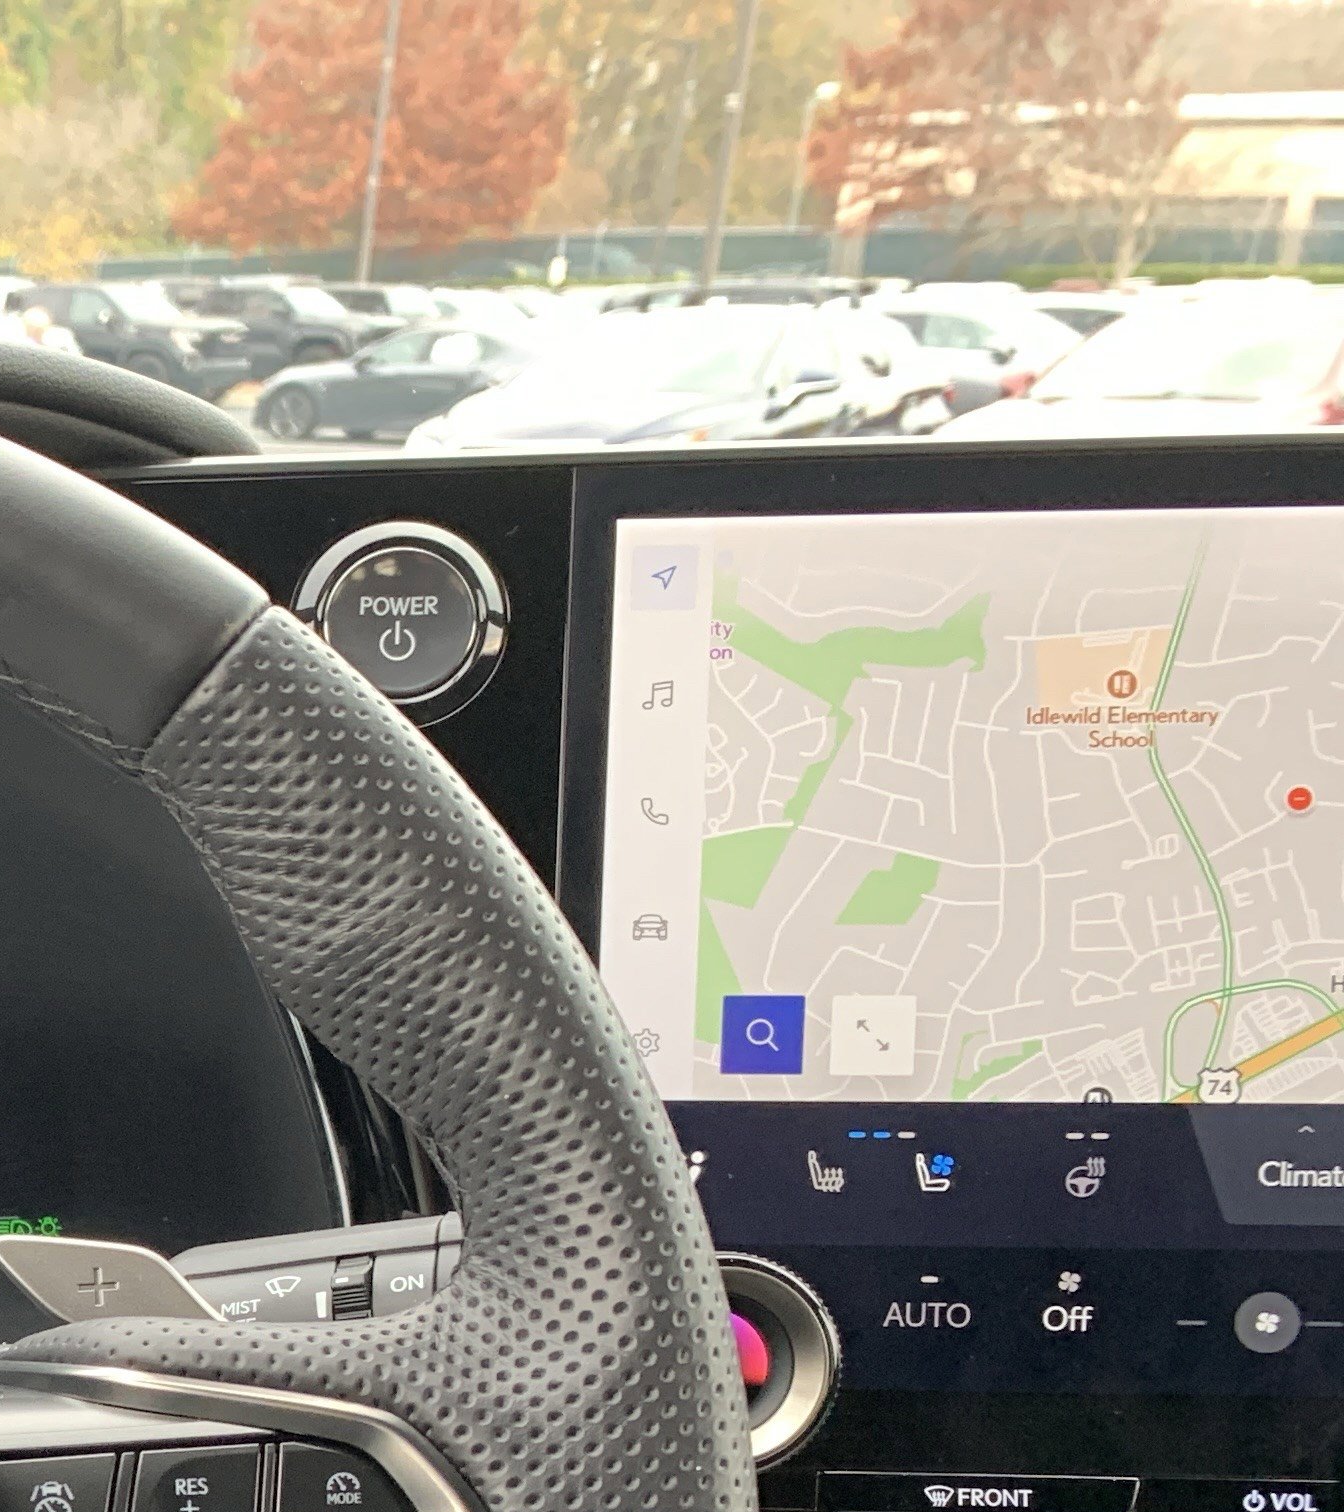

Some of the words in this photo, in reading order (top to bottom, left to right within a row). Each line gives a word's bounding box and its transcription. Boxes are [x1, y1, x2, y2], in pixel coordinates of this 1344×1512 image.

[359, 595, 439, 616] POWER
[1026, 706, 1101, 725] Idlewild
[1108, 706, 1219, 727] Elementary
[1089, 730, 1154, 748] School
[1207, 1080, 1232, 1096] 74
[390, 1273, 425, 1293] ON
[221, 1299, 261, 1317] MIST
[882, 1301, 972, 1329] AUTO
[1042, 1304, 1095, 1332] Off
[175, 1477, 209, 1497] RES
[326, 1491, 363, 1505] MODE
[957, 1488, 1033, 1508] FRONT
[1270, 1494, 1320, 1512] VOL
